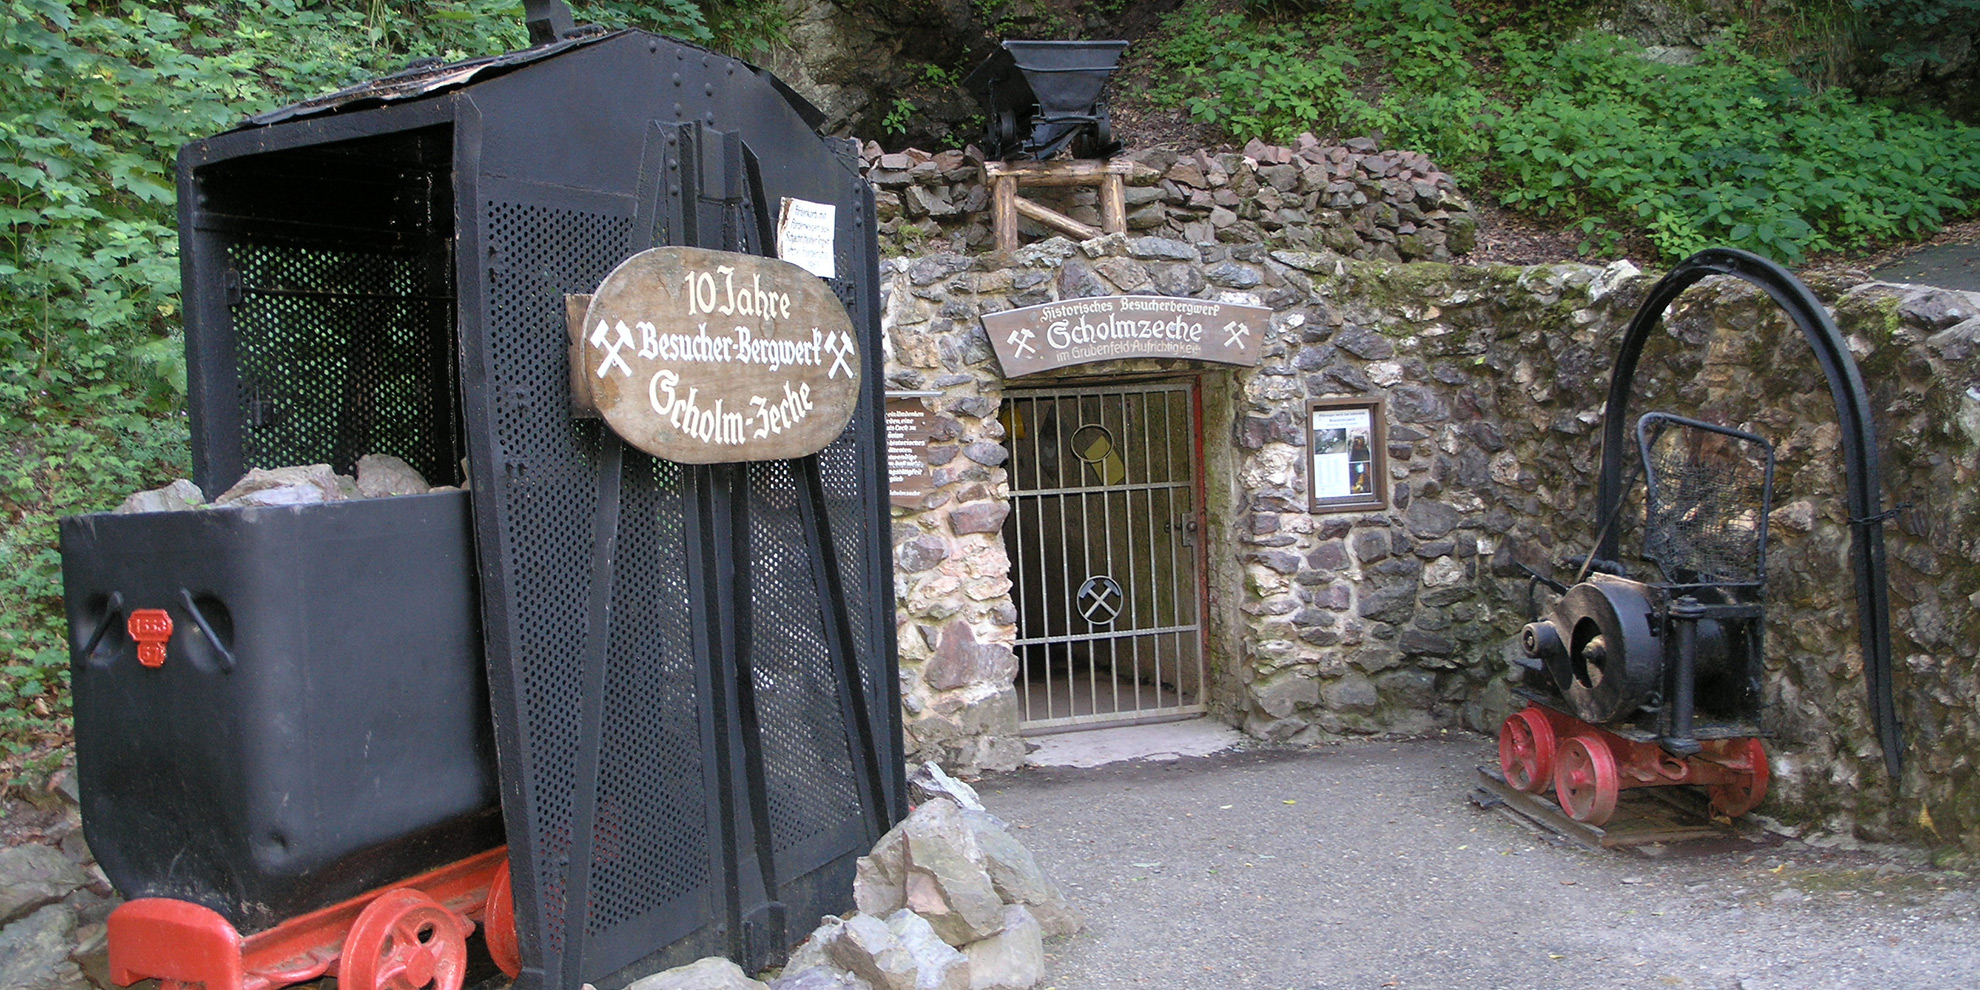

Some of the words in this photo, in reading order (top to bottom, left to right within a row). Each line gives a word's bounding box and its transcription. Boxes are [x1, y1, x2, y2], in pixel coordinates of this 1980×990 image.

[684, 270, 716, 316] 10
[717, 265, 791, 321] Jahre
[1040, 301, 1113, 323] Historisches
[1120, 297, 1220, 317] Besucherbergwerk
[1047, 312, 1203, 349] Scholmzeche
[1056, 350, 1070, 363] im
[1072, 341, 1130, 359] Grubenfeld
